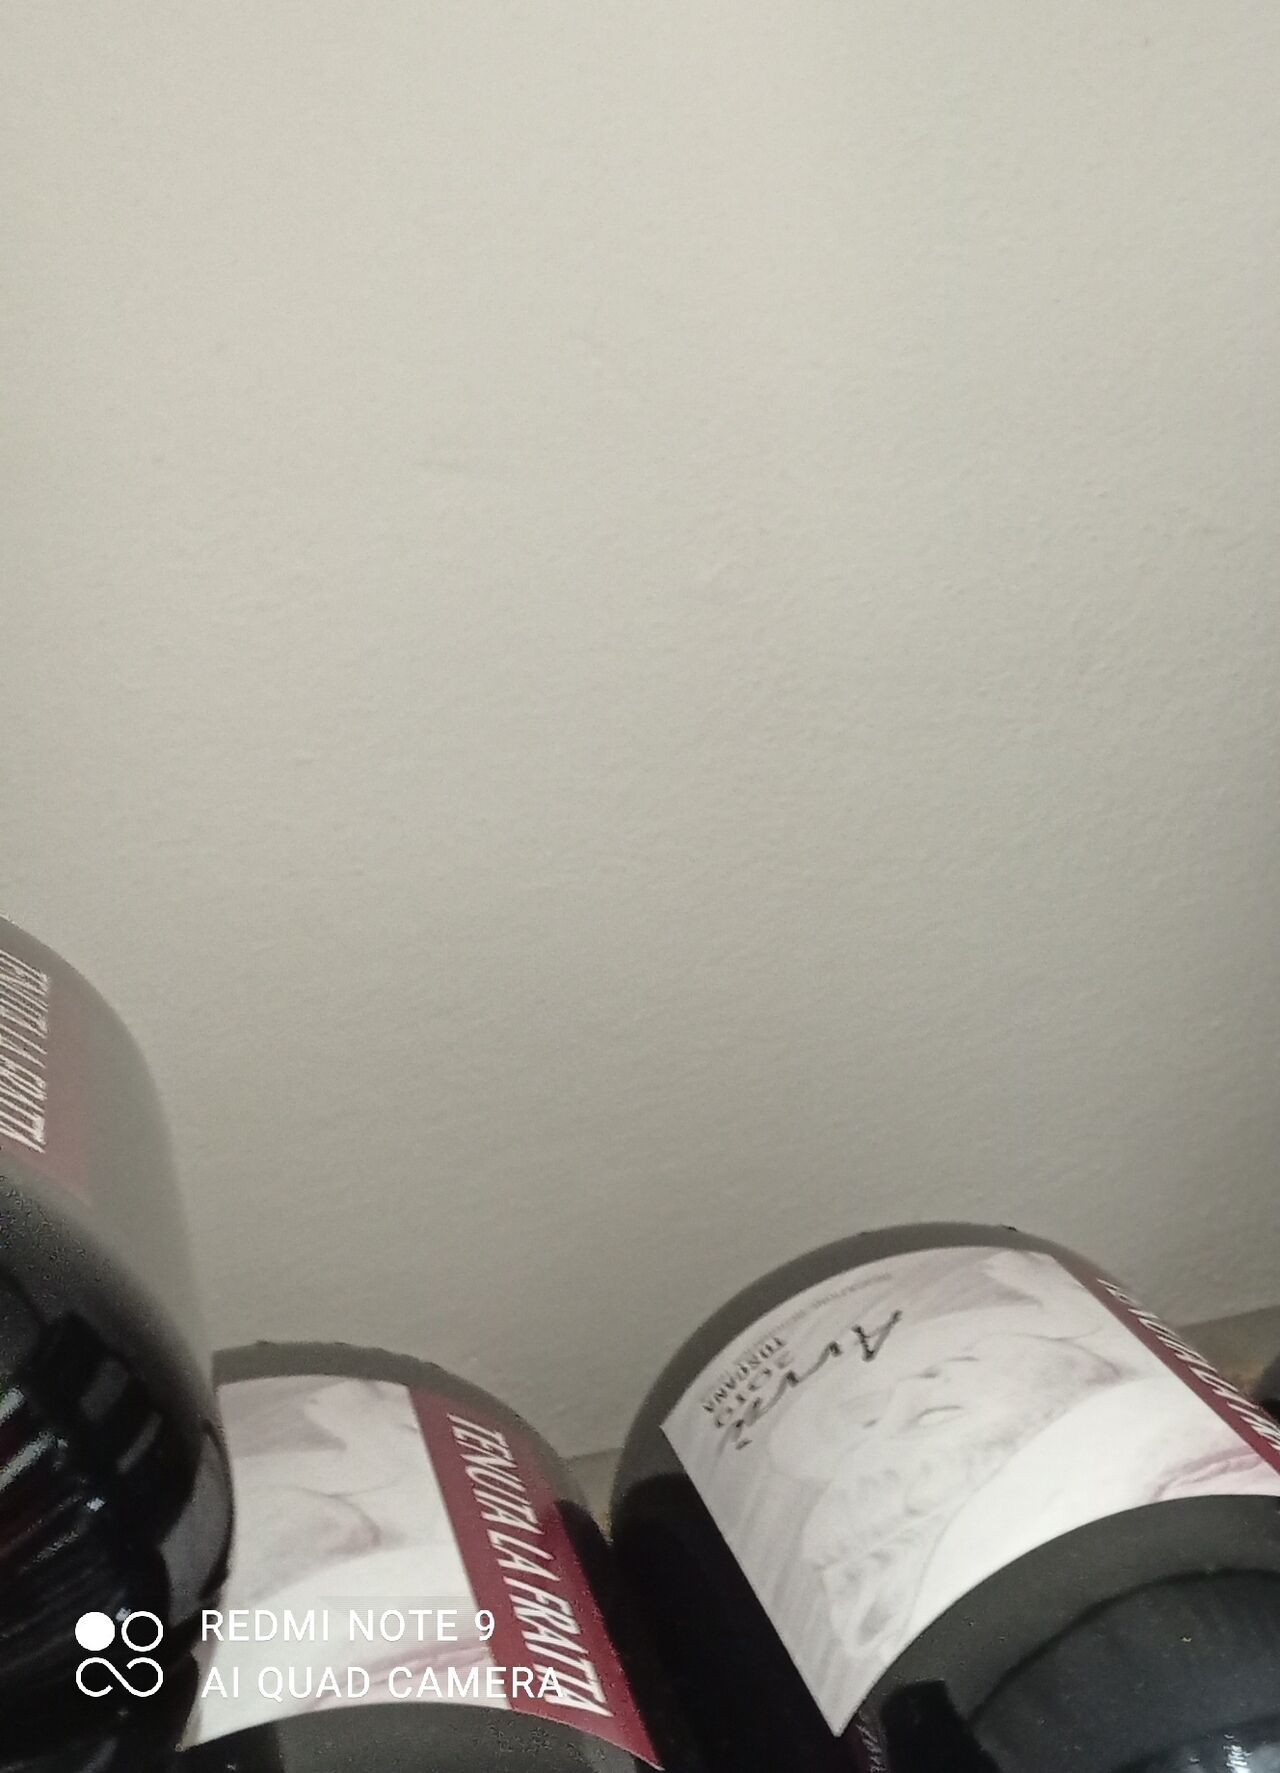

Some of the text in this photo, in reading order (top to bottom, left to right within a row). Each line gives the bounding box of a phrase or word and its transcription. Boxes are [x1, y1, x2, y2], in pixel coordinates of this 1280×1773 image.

[446, 1412, 614, 1718] TENUTA LA FRATTA
